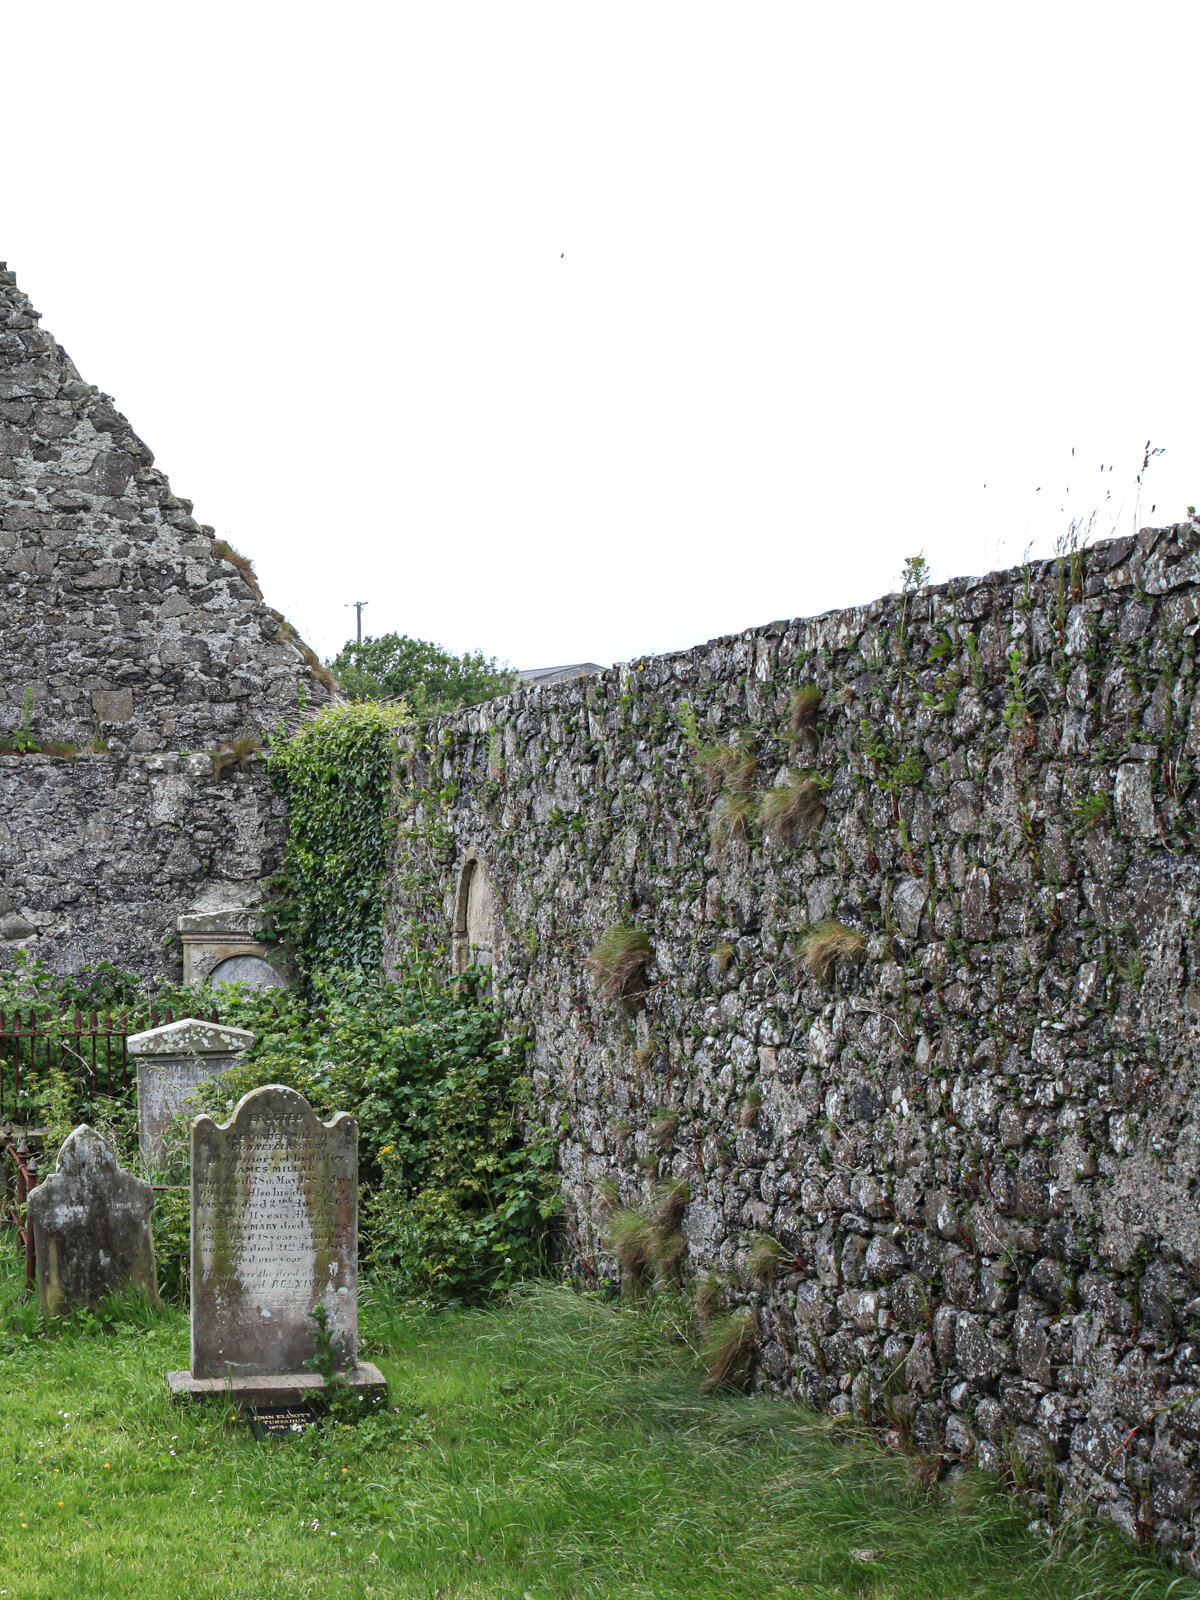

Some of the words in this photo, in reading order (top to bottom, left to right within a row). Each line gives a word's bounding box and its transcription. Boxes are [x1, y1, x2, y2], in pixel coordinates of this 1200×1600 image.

[250, 1112, 303, 1123] ERECTED
[225, 1133, 288, 1142] ALEXANDER
[291, 1132, 328, 1141] MILLAR
[279, 1153, 291, 1163] of
[234, 1166, 268, 1175] JAMES
[272, 1165, 315, 1175] MILLAR
[276, 1174, 297, 1188] May
[249, 1187, 271, 1197] Also
[272, 1186, 289, 1197] his
[240, 1199, 268, 1210] died
[250, 1223, 278, 1231] MARY
[279, 1220, 305, 1230] died
[249, 1243, 274, 1253] died
[258, 1256, 277, 1264] one
[259, 1269, 275, 1279] the
[275, 1268, 301, 1279] dead
